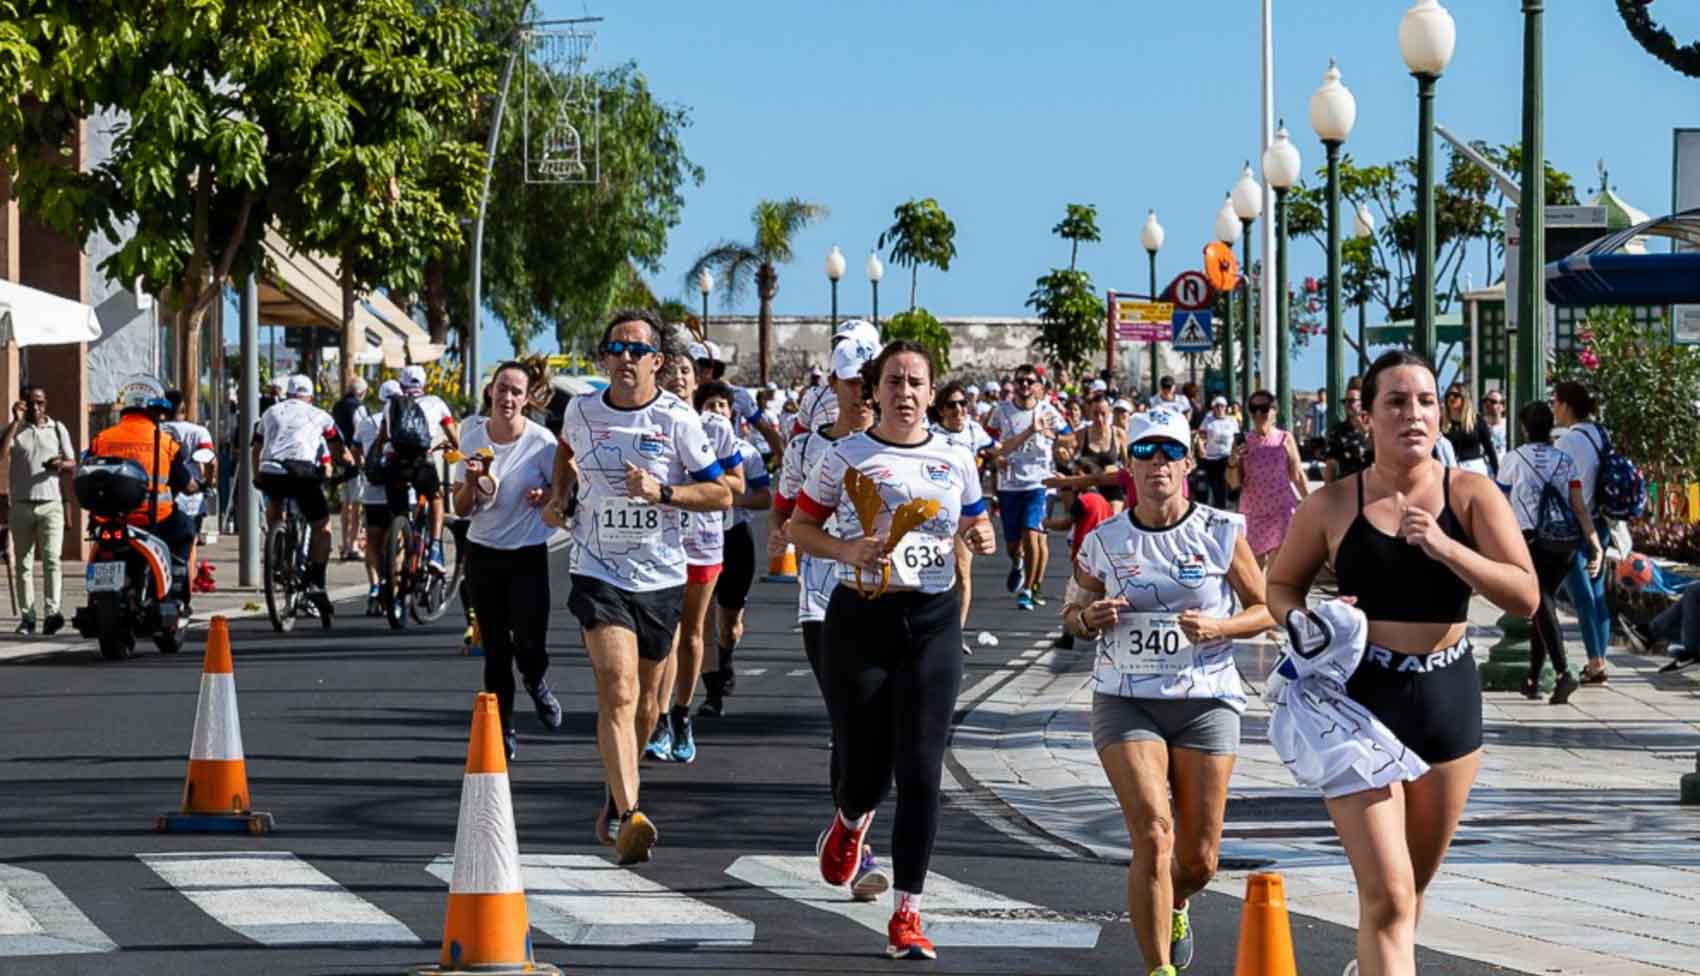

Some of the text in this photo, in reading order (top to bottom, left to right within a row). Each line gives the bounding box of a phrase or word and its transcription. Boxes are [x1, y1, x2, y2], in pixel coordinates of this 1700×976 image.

[603, 508, 658, 529] 1118
[904, 544, 945, 568] 638
[1129, 629, 1179, 655] 340
